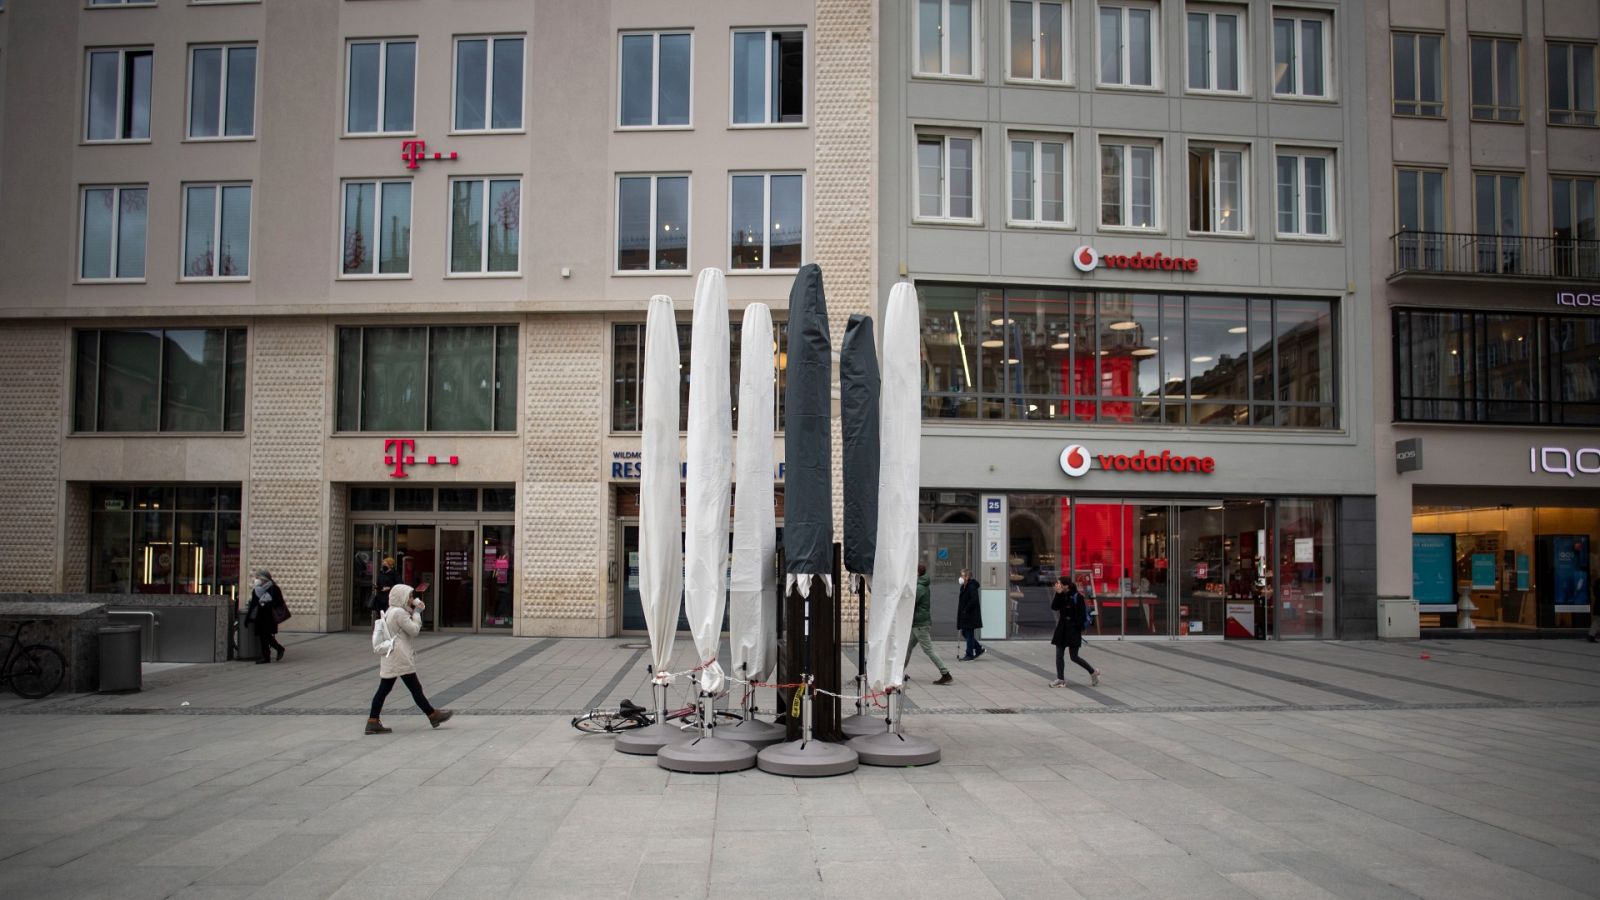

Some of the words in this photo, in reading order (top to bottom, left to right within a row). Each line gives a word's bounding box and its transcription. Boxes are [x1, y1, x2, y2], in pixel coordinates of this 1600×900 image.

[1104, 251, 1199, 272] vodafone
[1557, 293, 1600, 306] IQOS
[1097, 449, 1215, 473] vodafone
